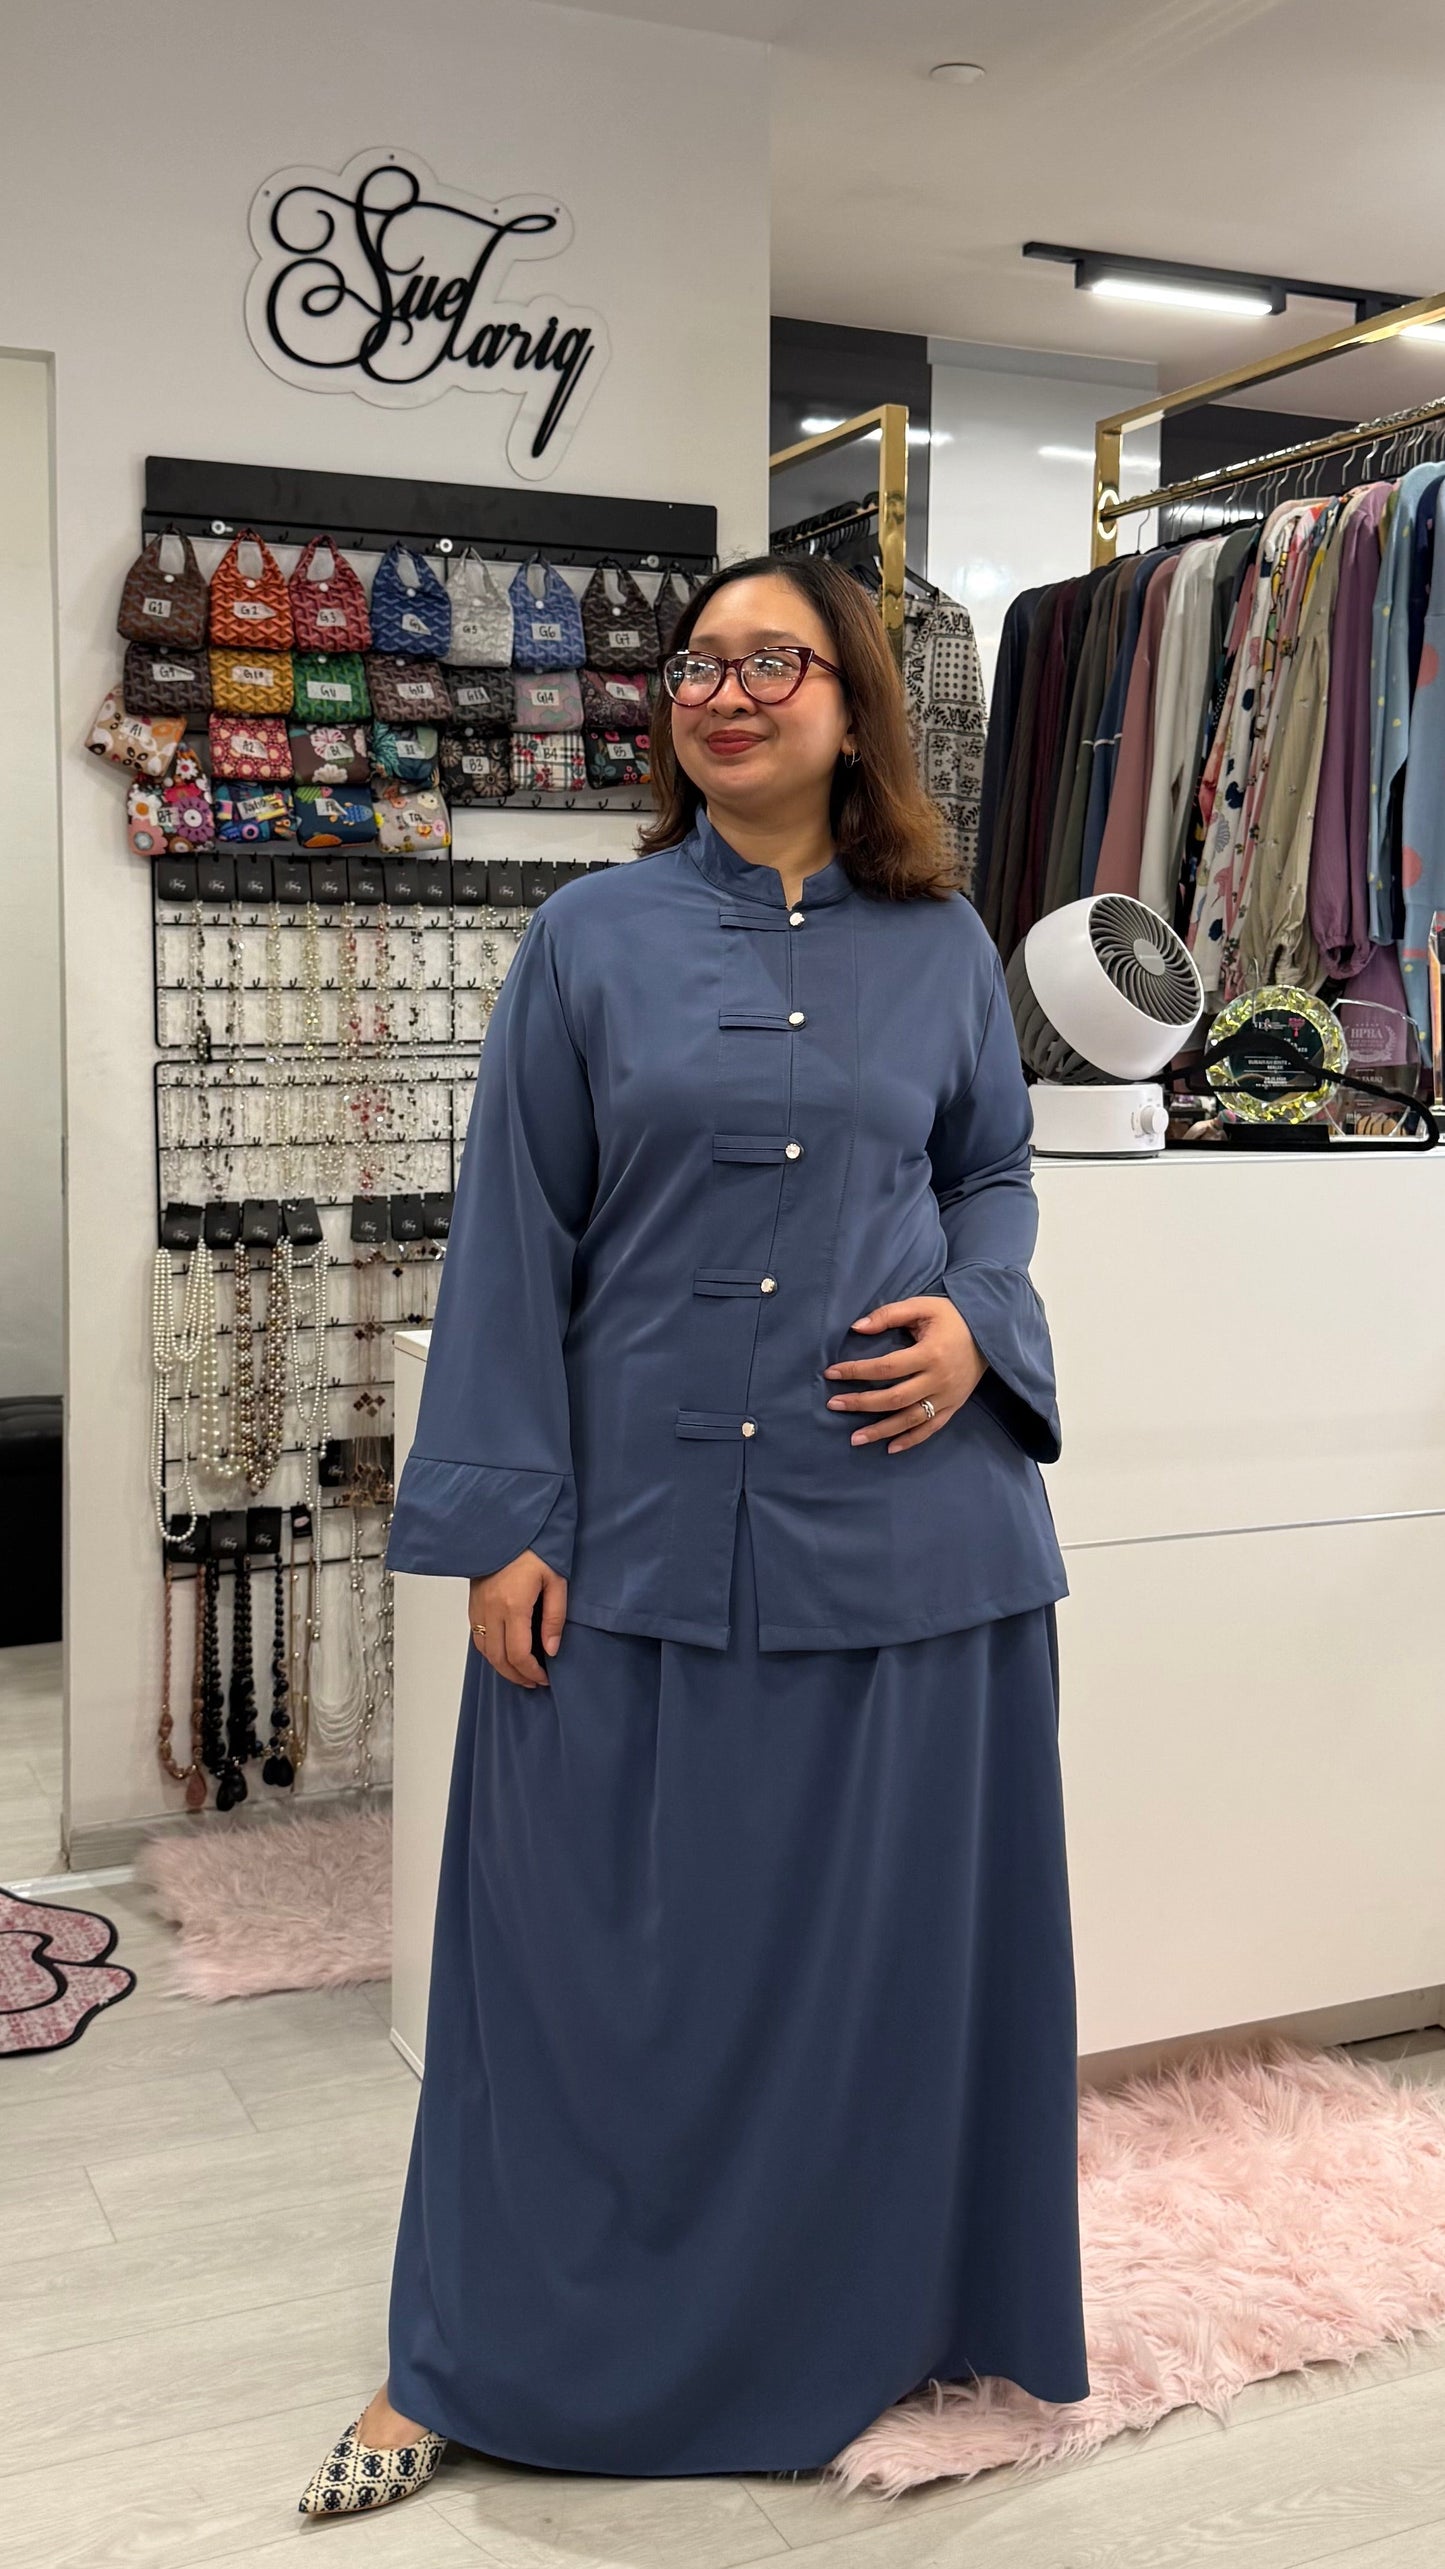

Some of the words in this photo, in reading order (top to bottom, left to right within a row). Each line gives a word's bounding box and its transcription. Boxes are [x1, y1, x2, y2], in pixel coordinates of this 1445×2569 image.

[267, 166, 471, 368] Sue
[148, 601, 163, 614] G1
[240, 606, 258, 615] G2
[319, 611, 336, 623] G3
[462, 625, 477, 634] G5
[538, 625, 556, 638] G6
[615, 633, 630, 646] G7
[408, 684, 425, 696] G12
[536, 692, 554, 704] G14
[543, 747, 558, 760] B4
[613, 745, 626, 758] B5
[468, 759, 483, 773] B3
[157, 810, 173, 824] B7
